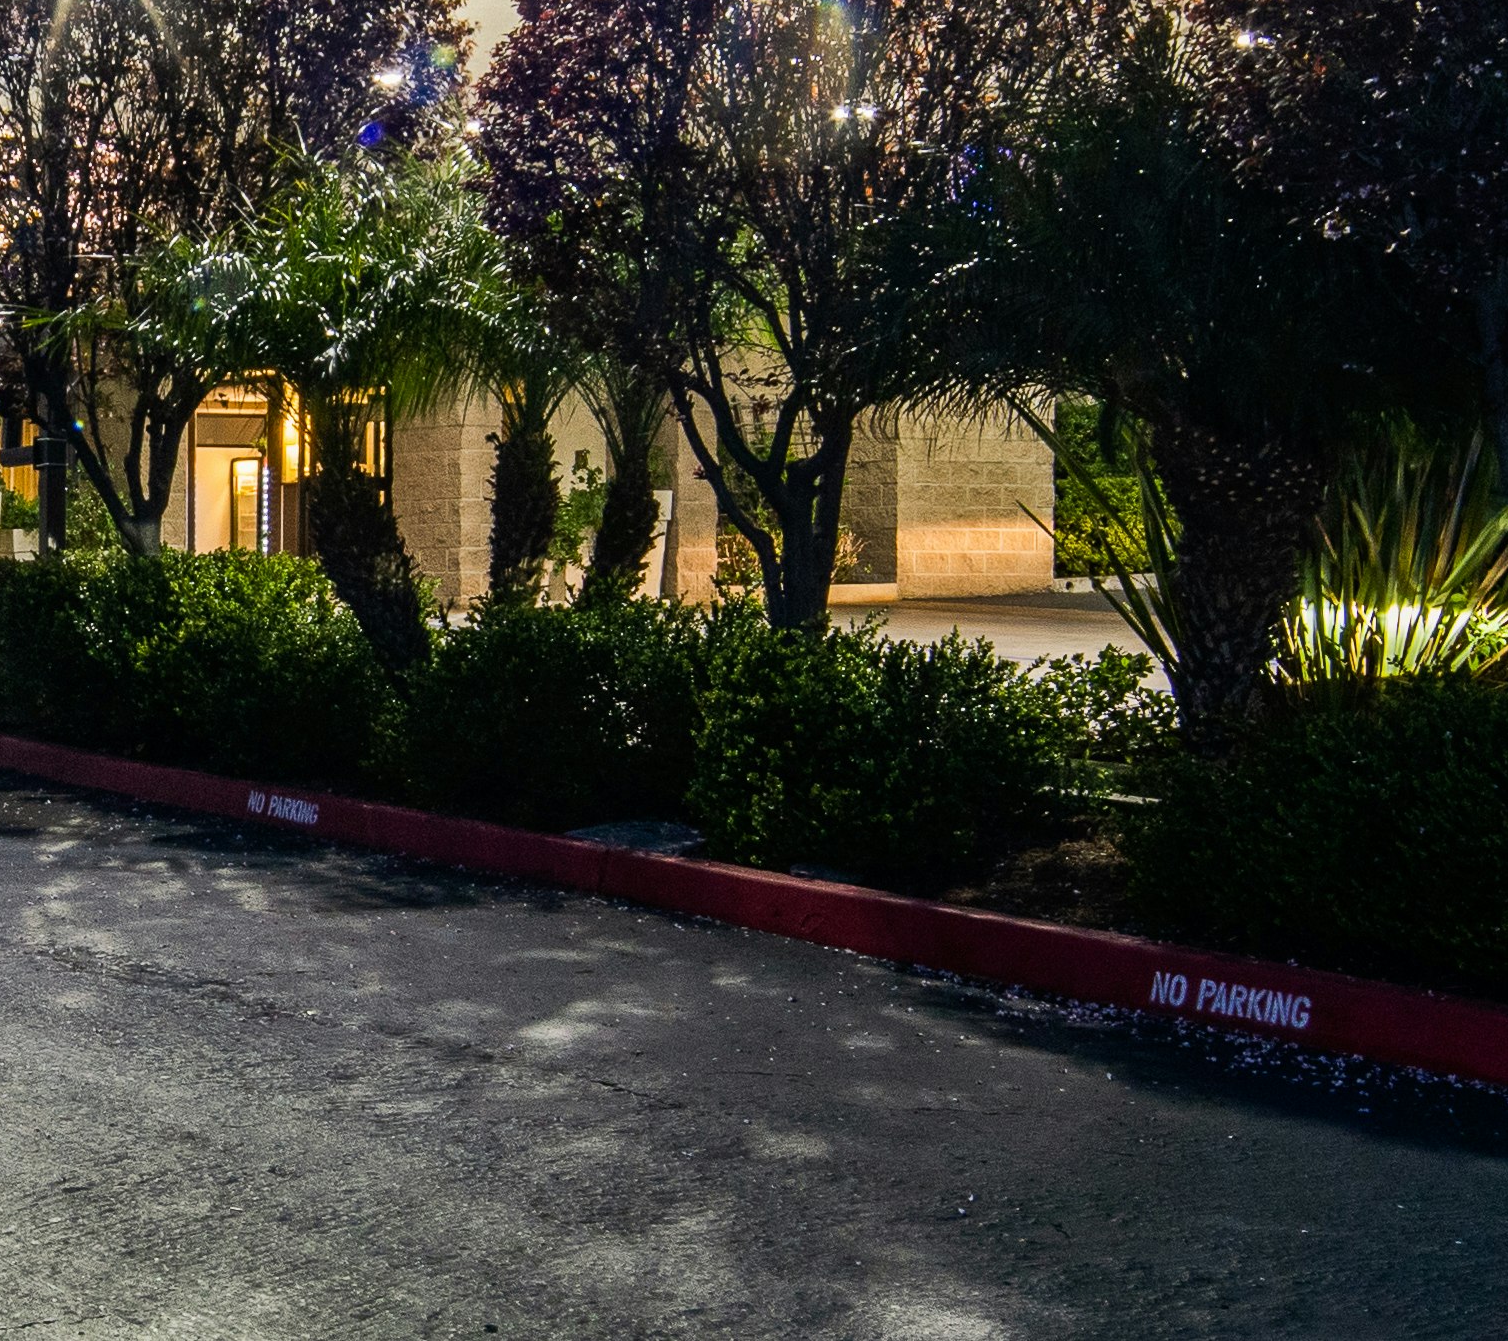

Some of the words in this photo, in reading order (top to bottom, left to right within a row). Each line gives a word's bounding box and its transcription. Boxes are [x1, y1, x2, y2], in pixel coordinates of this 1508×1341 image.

[247, 790, 266, 814] NO
[267, 794, 320, 825] PARKING
[1150, 970, 1188, 1008] NO
[1196, 978, 1312, 1030] PARKING
